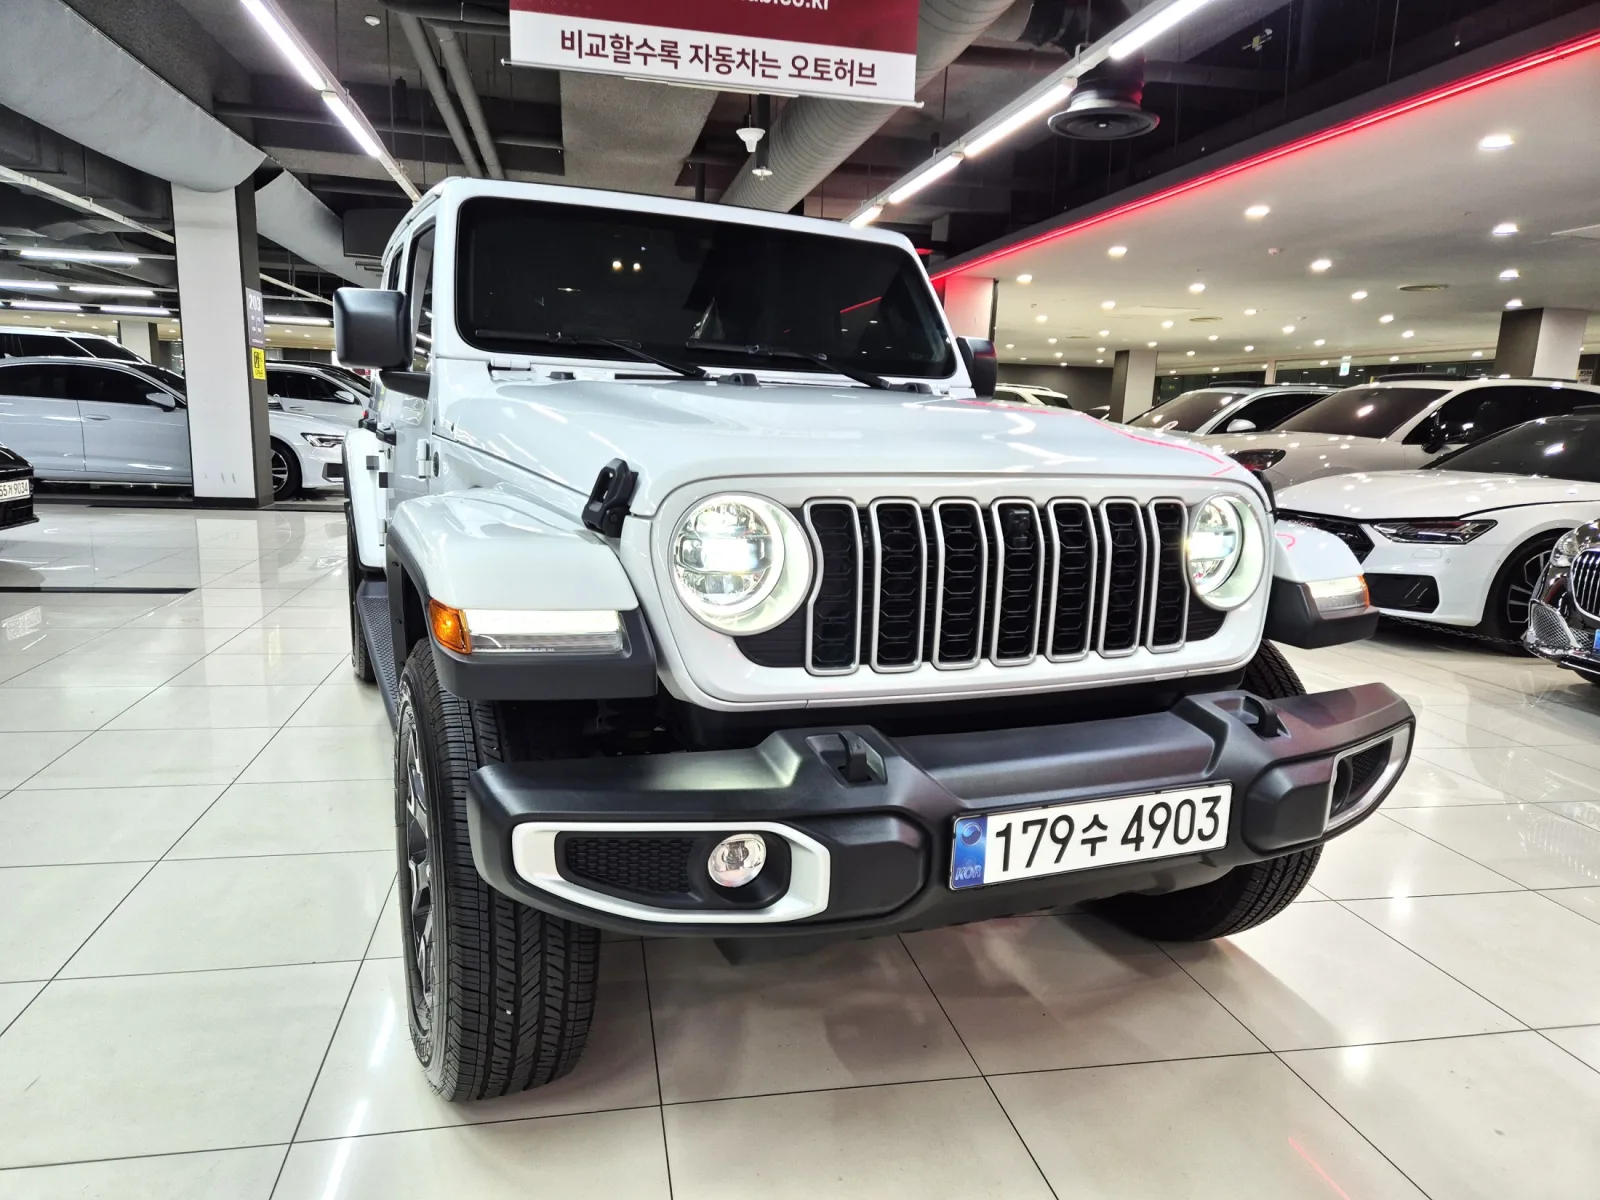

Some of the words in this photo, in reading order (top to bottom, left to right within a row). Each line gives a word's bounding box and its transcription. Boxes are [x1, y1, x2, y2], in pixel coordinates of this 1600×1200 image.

[561, 29, 681, 70] 비교할수록
[688, 43, 782, 80] 자동차는
[788, 55, 877, 87] 오토허브
[249, 293, 261, 312] 203
[955, 863, 983, 881] KOR
